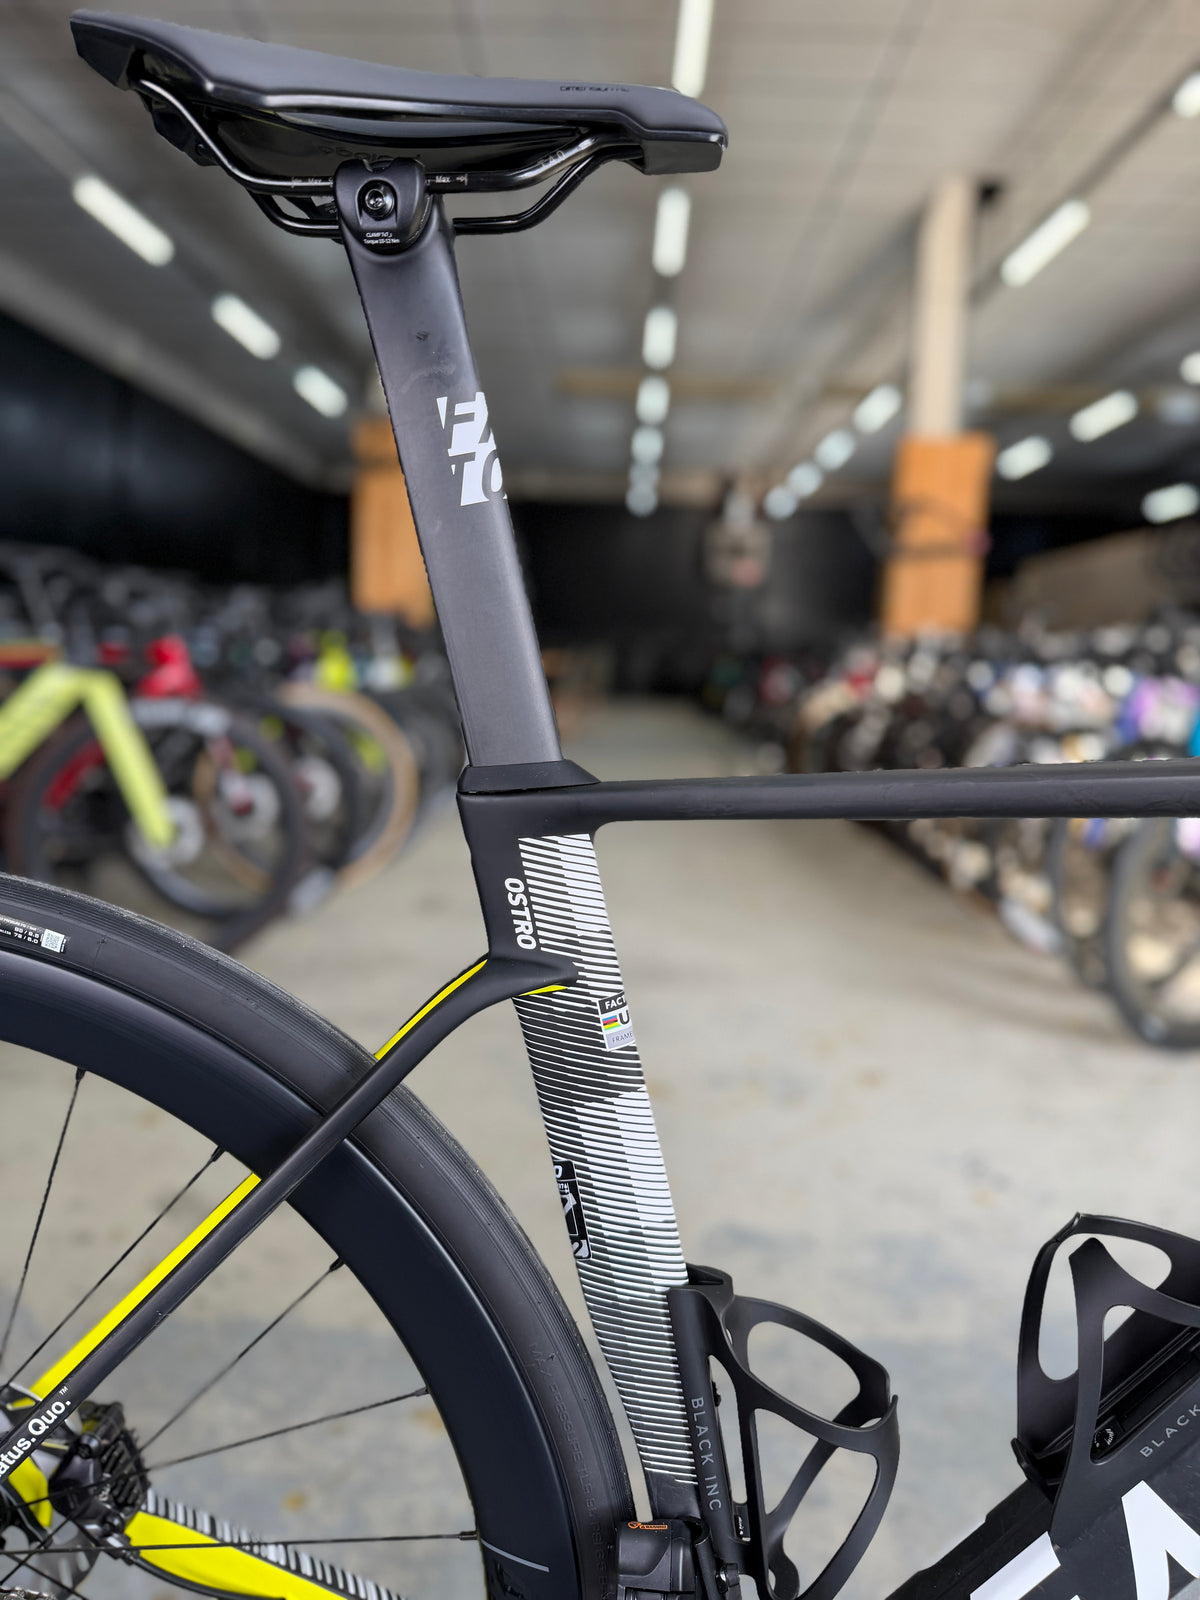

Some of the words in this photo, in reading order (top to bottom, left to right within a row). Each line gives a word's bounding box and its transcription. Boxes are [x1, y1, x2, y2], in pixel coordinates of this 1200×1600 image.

[504, 877, 537, 950] OSTRO
[0, 1401, 71, 1478] atus.Quo.
[691, 1396, 714, 1466] BLACK
[704, 1475, 722, 1511] INC
[1139, 1404, 1200, 1457] BLACK
